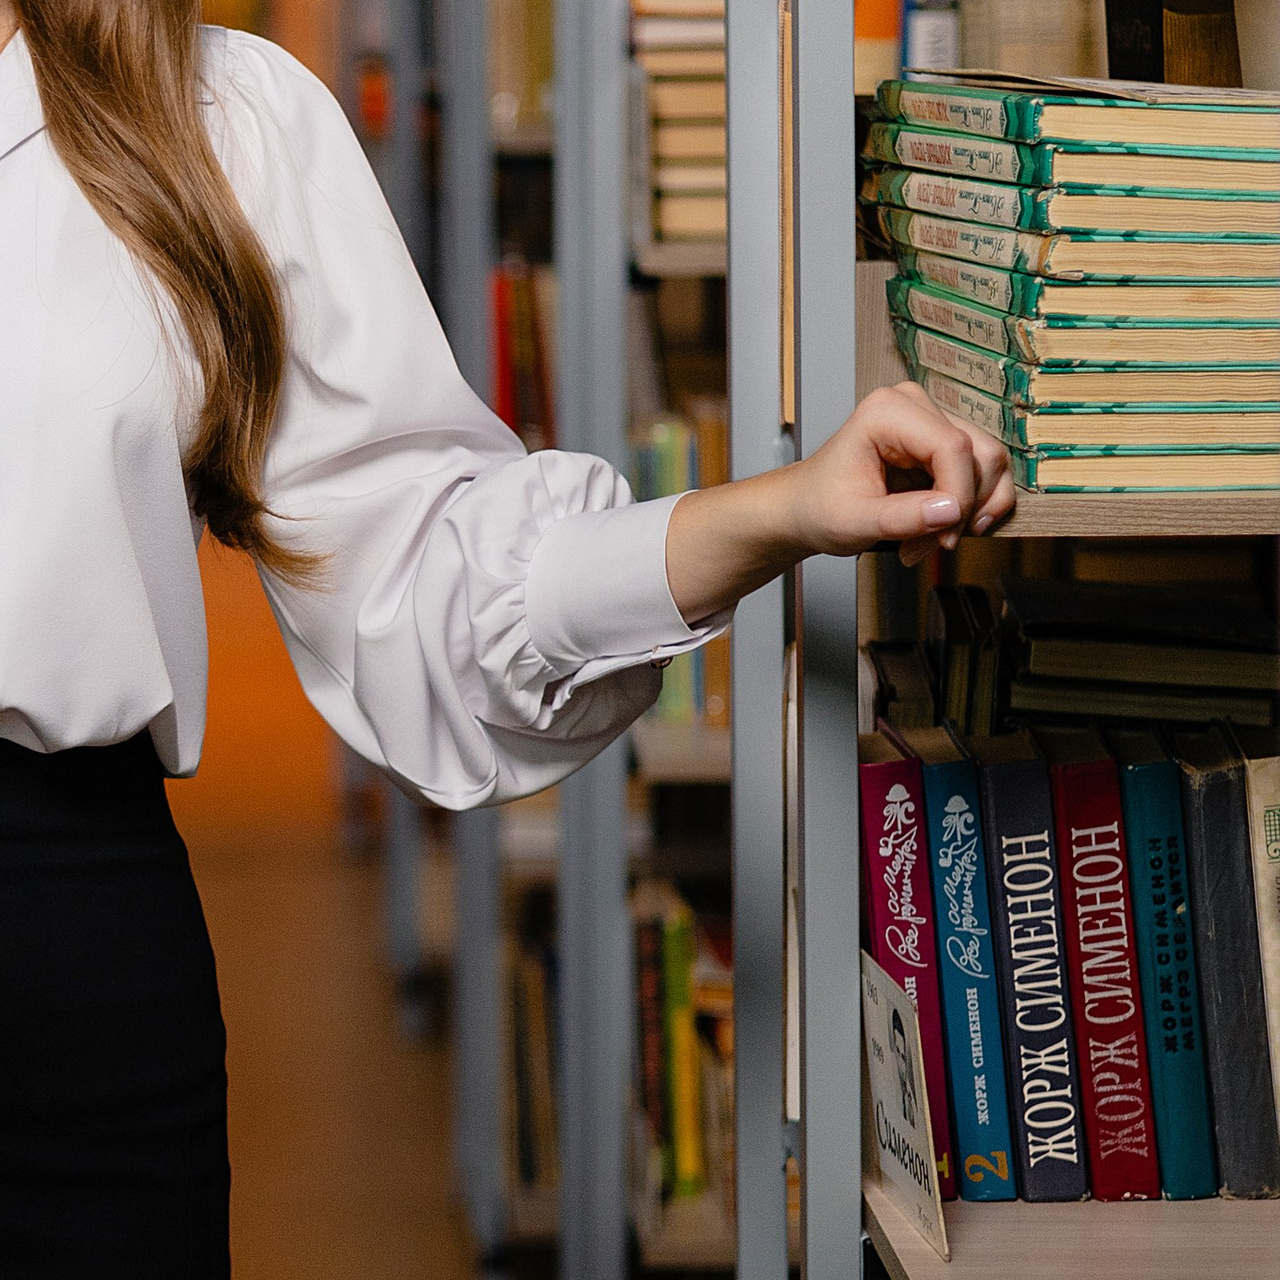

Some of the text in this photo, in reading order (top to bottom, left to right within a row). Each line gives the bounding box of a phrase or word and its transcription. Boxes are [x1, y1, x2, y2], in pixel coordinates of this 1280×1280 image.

[1001, 829, 1079, 1169] ЖОРЖ СИМЕНОН
[1071, 820, 1149, 1160] ЖОРЖ СИМЕНОН
[1149, 837, 1178, 1052] ЖОРЖ СИМЕНОН
[1177, 970, 1194, 1050] МЕГРЭ
[965, 988, 990, 1125] ЖОРЖ СИМЕНОН
[876, 1101, 932, 1196] Сименон
[964, 1151, 1008, 1182] 2
